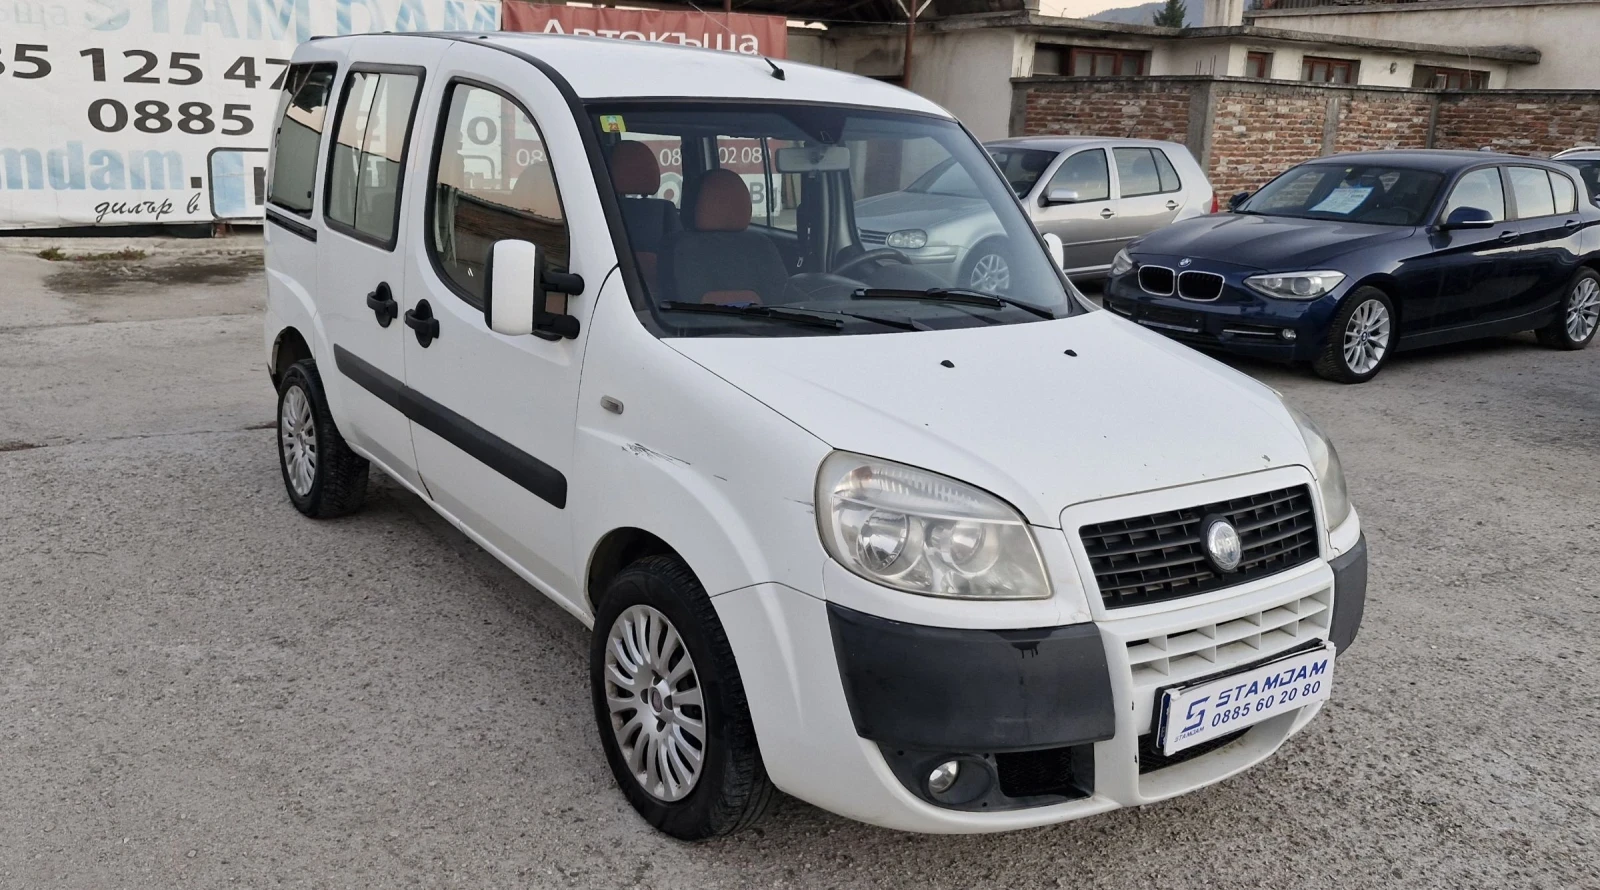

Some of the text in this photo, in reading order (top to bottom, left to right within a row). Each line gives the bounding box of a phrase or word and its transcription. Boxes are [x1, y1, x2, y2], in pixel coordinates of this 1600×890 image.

[0, 43, 52, 80] 5
[79, 47, 204, 86] 125
[87, 98, 255, 136] 0885
[516, 148, 548, 167] 08
[741, 147, 771, 164] 08
[94, 198, 174, 223] дилър
[1211, 680, 1321, 727] 0885 60 20 80
